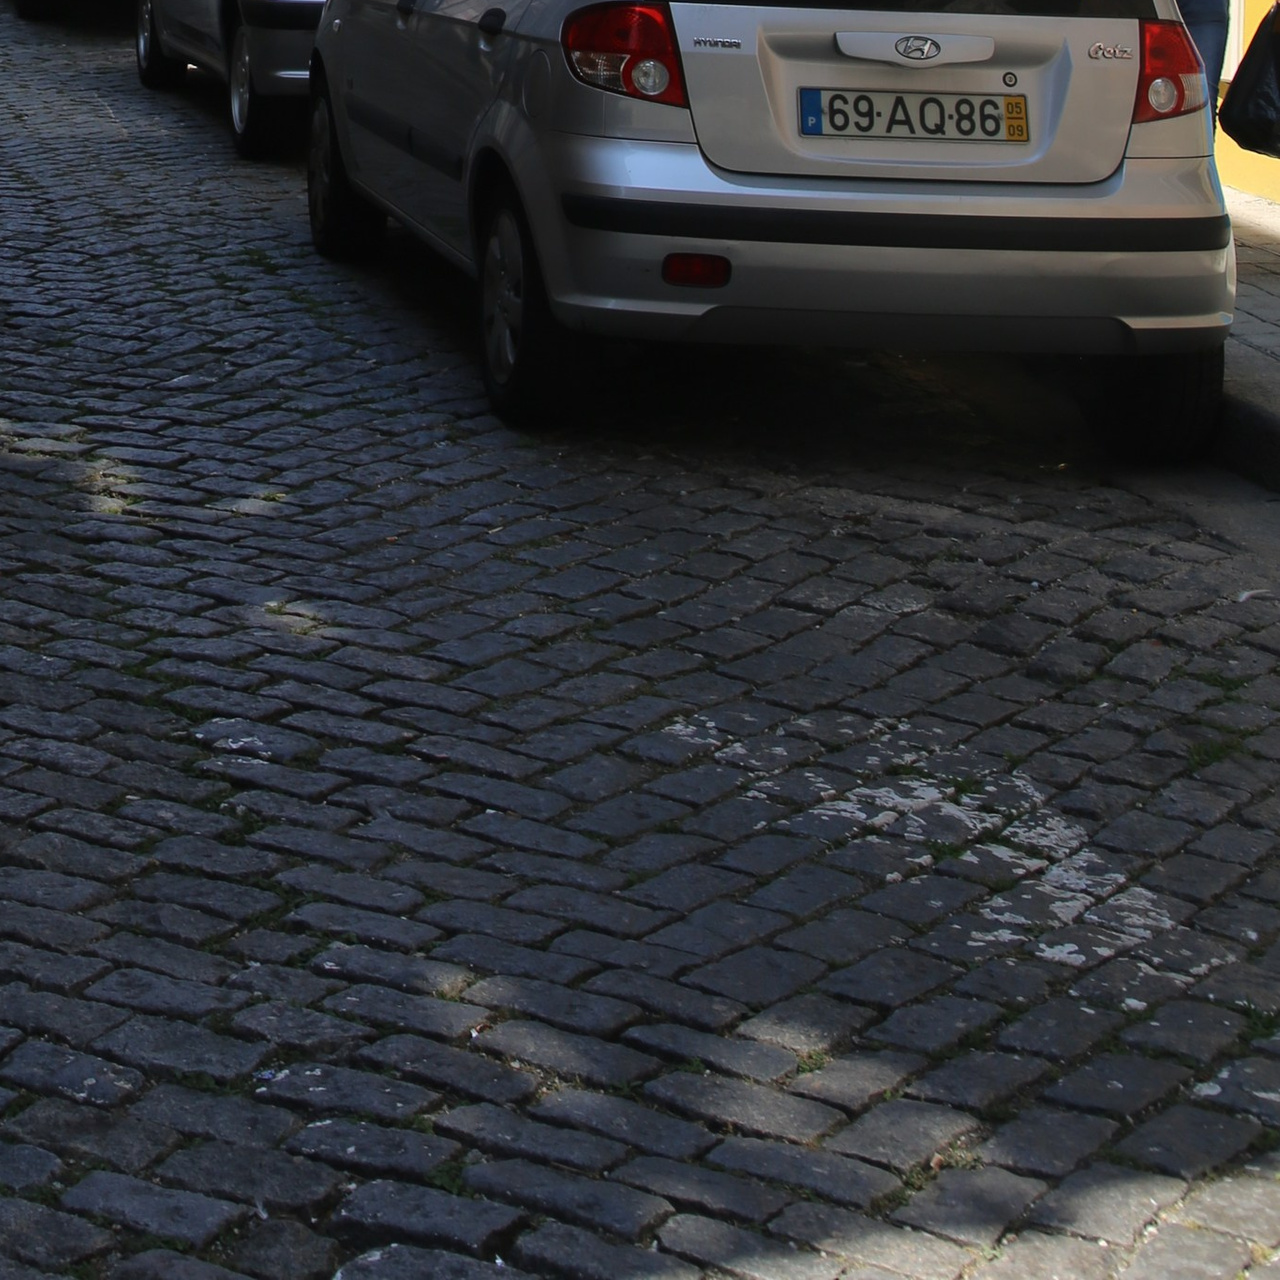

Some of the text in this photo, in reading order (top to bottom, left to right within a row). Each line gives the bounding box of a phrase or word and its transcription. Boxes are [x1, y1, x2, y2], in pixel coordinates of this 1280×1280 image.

[693, 37, 741, 49] HYUNDAI
[1088, 42, 1133, 60] Getz
[1006, 101, 1022, 115] 05
[808, 116, 816, 126] P
[1008, 124, 1024, 137] 09
